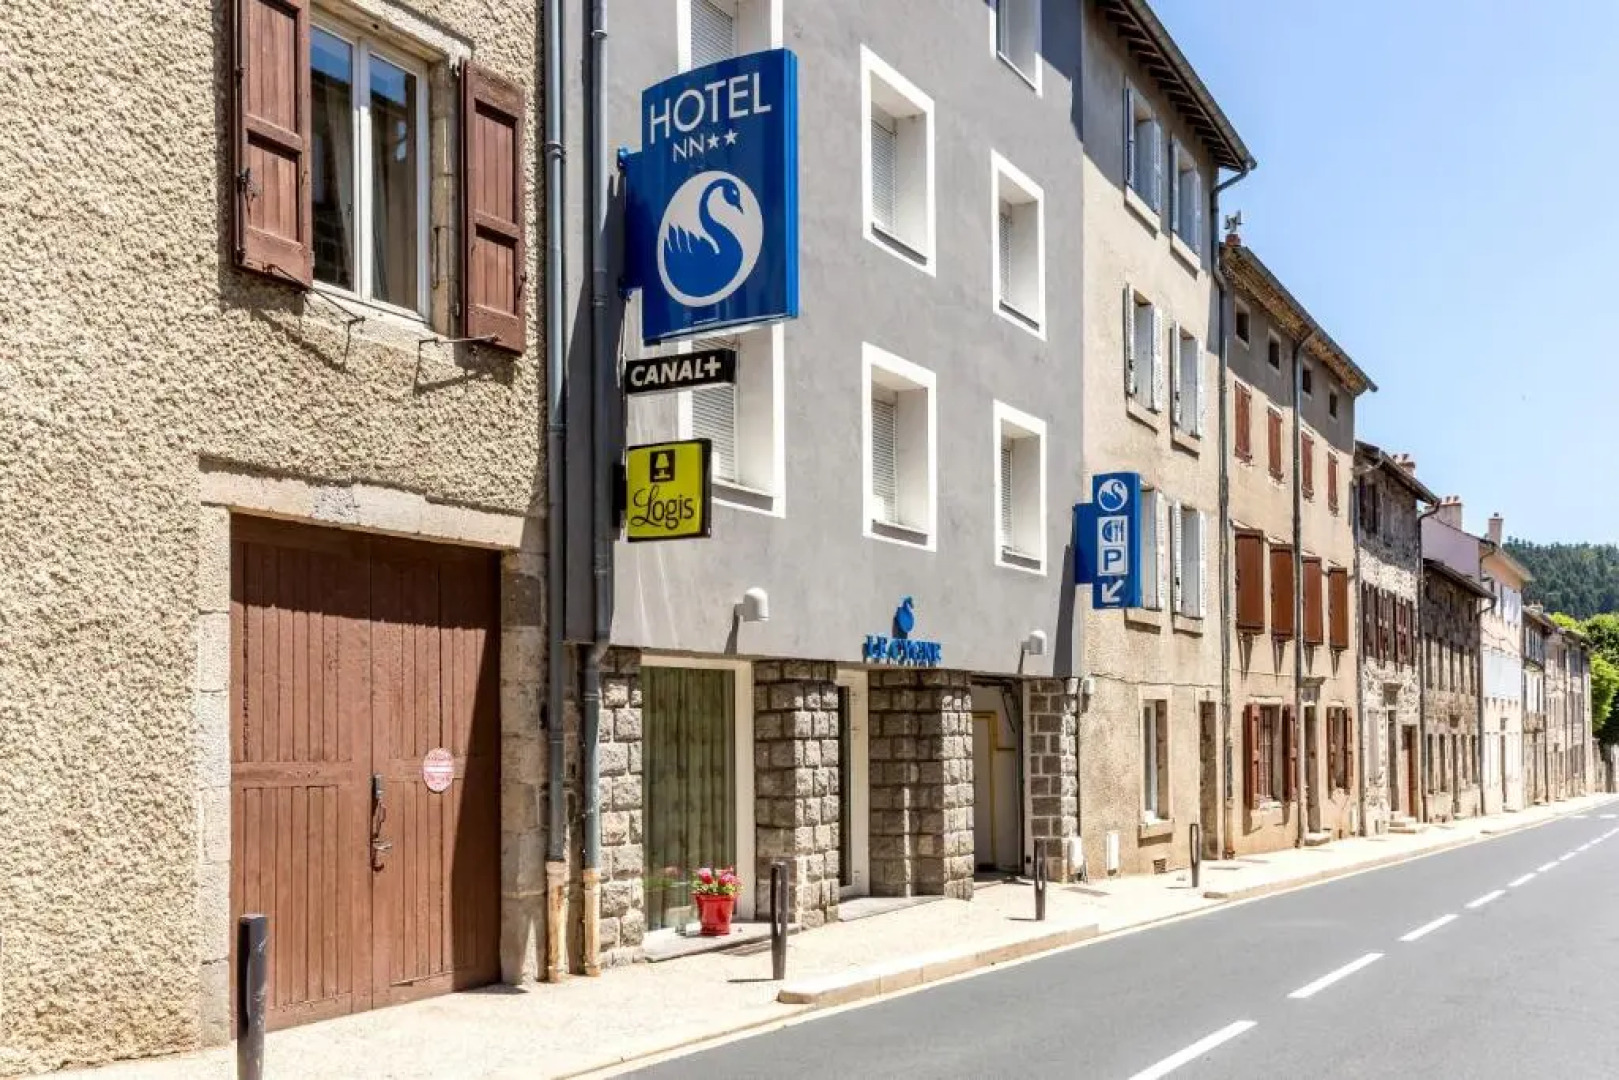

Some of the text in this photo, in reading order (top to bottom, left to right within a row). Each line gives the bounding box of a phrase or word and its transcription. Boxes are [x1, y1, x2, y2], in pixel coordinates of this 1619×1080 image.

[650, 72, 772, 145] HOTEL
[630, 355, 722, 387] CANAL+
[630, 485, 695, 530] Logis
[1104, 549, 1122, 571] P
